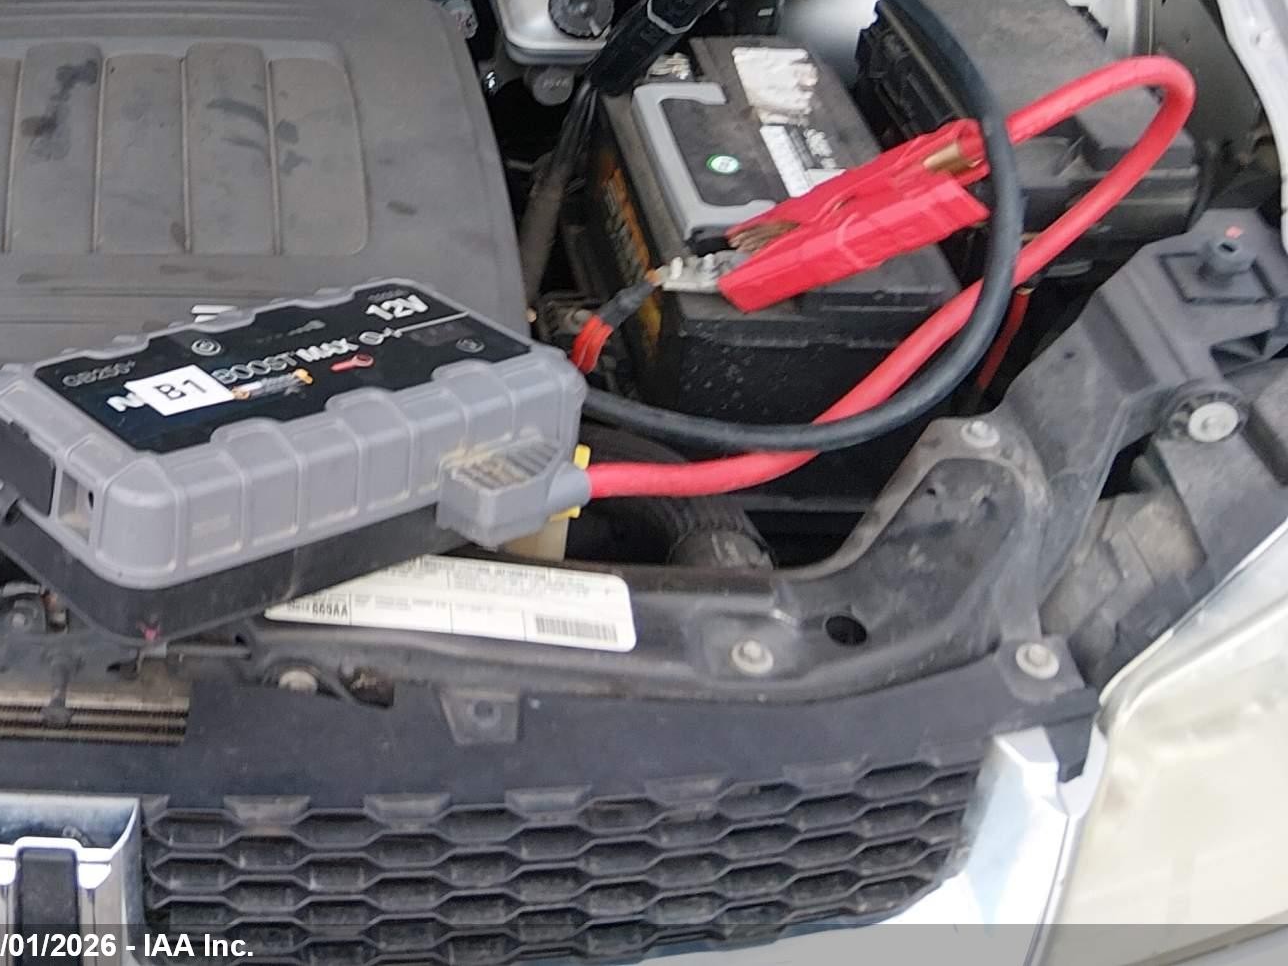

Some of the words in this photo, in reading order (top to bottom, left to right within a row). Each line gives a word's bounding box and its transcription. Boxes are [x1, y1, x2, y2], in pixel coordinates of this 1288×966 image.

[364, 293, 429, 321] 12V
[211, 351, 298, 384] BOOST
[152, 379, 208, 401] B1
